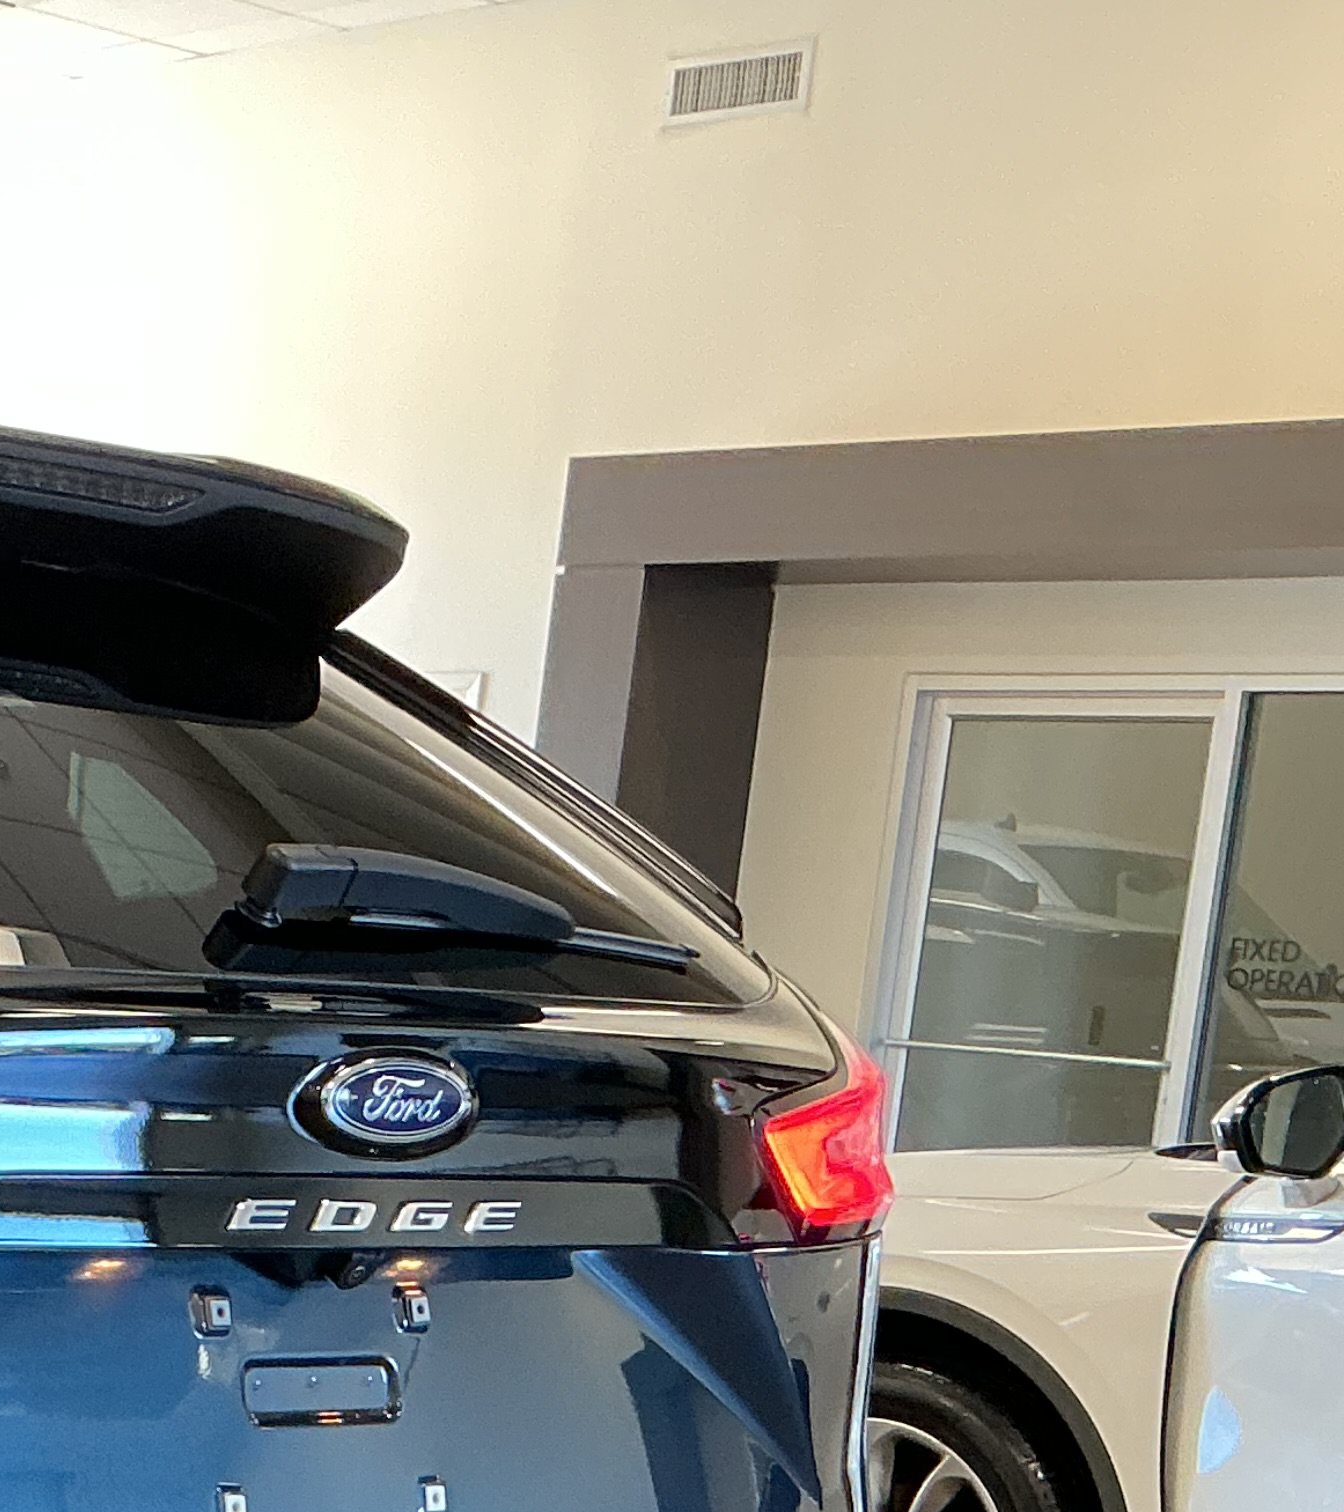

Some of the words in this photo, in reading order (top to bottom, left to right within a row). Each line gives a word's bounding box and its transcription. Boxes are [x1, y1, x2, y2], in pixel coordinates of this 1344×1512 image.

[1231, 937, 1302, 963] FIXED
[361, 1073, 445, 1125] Ford
[225, 1197, 523, 1235] EDGE
